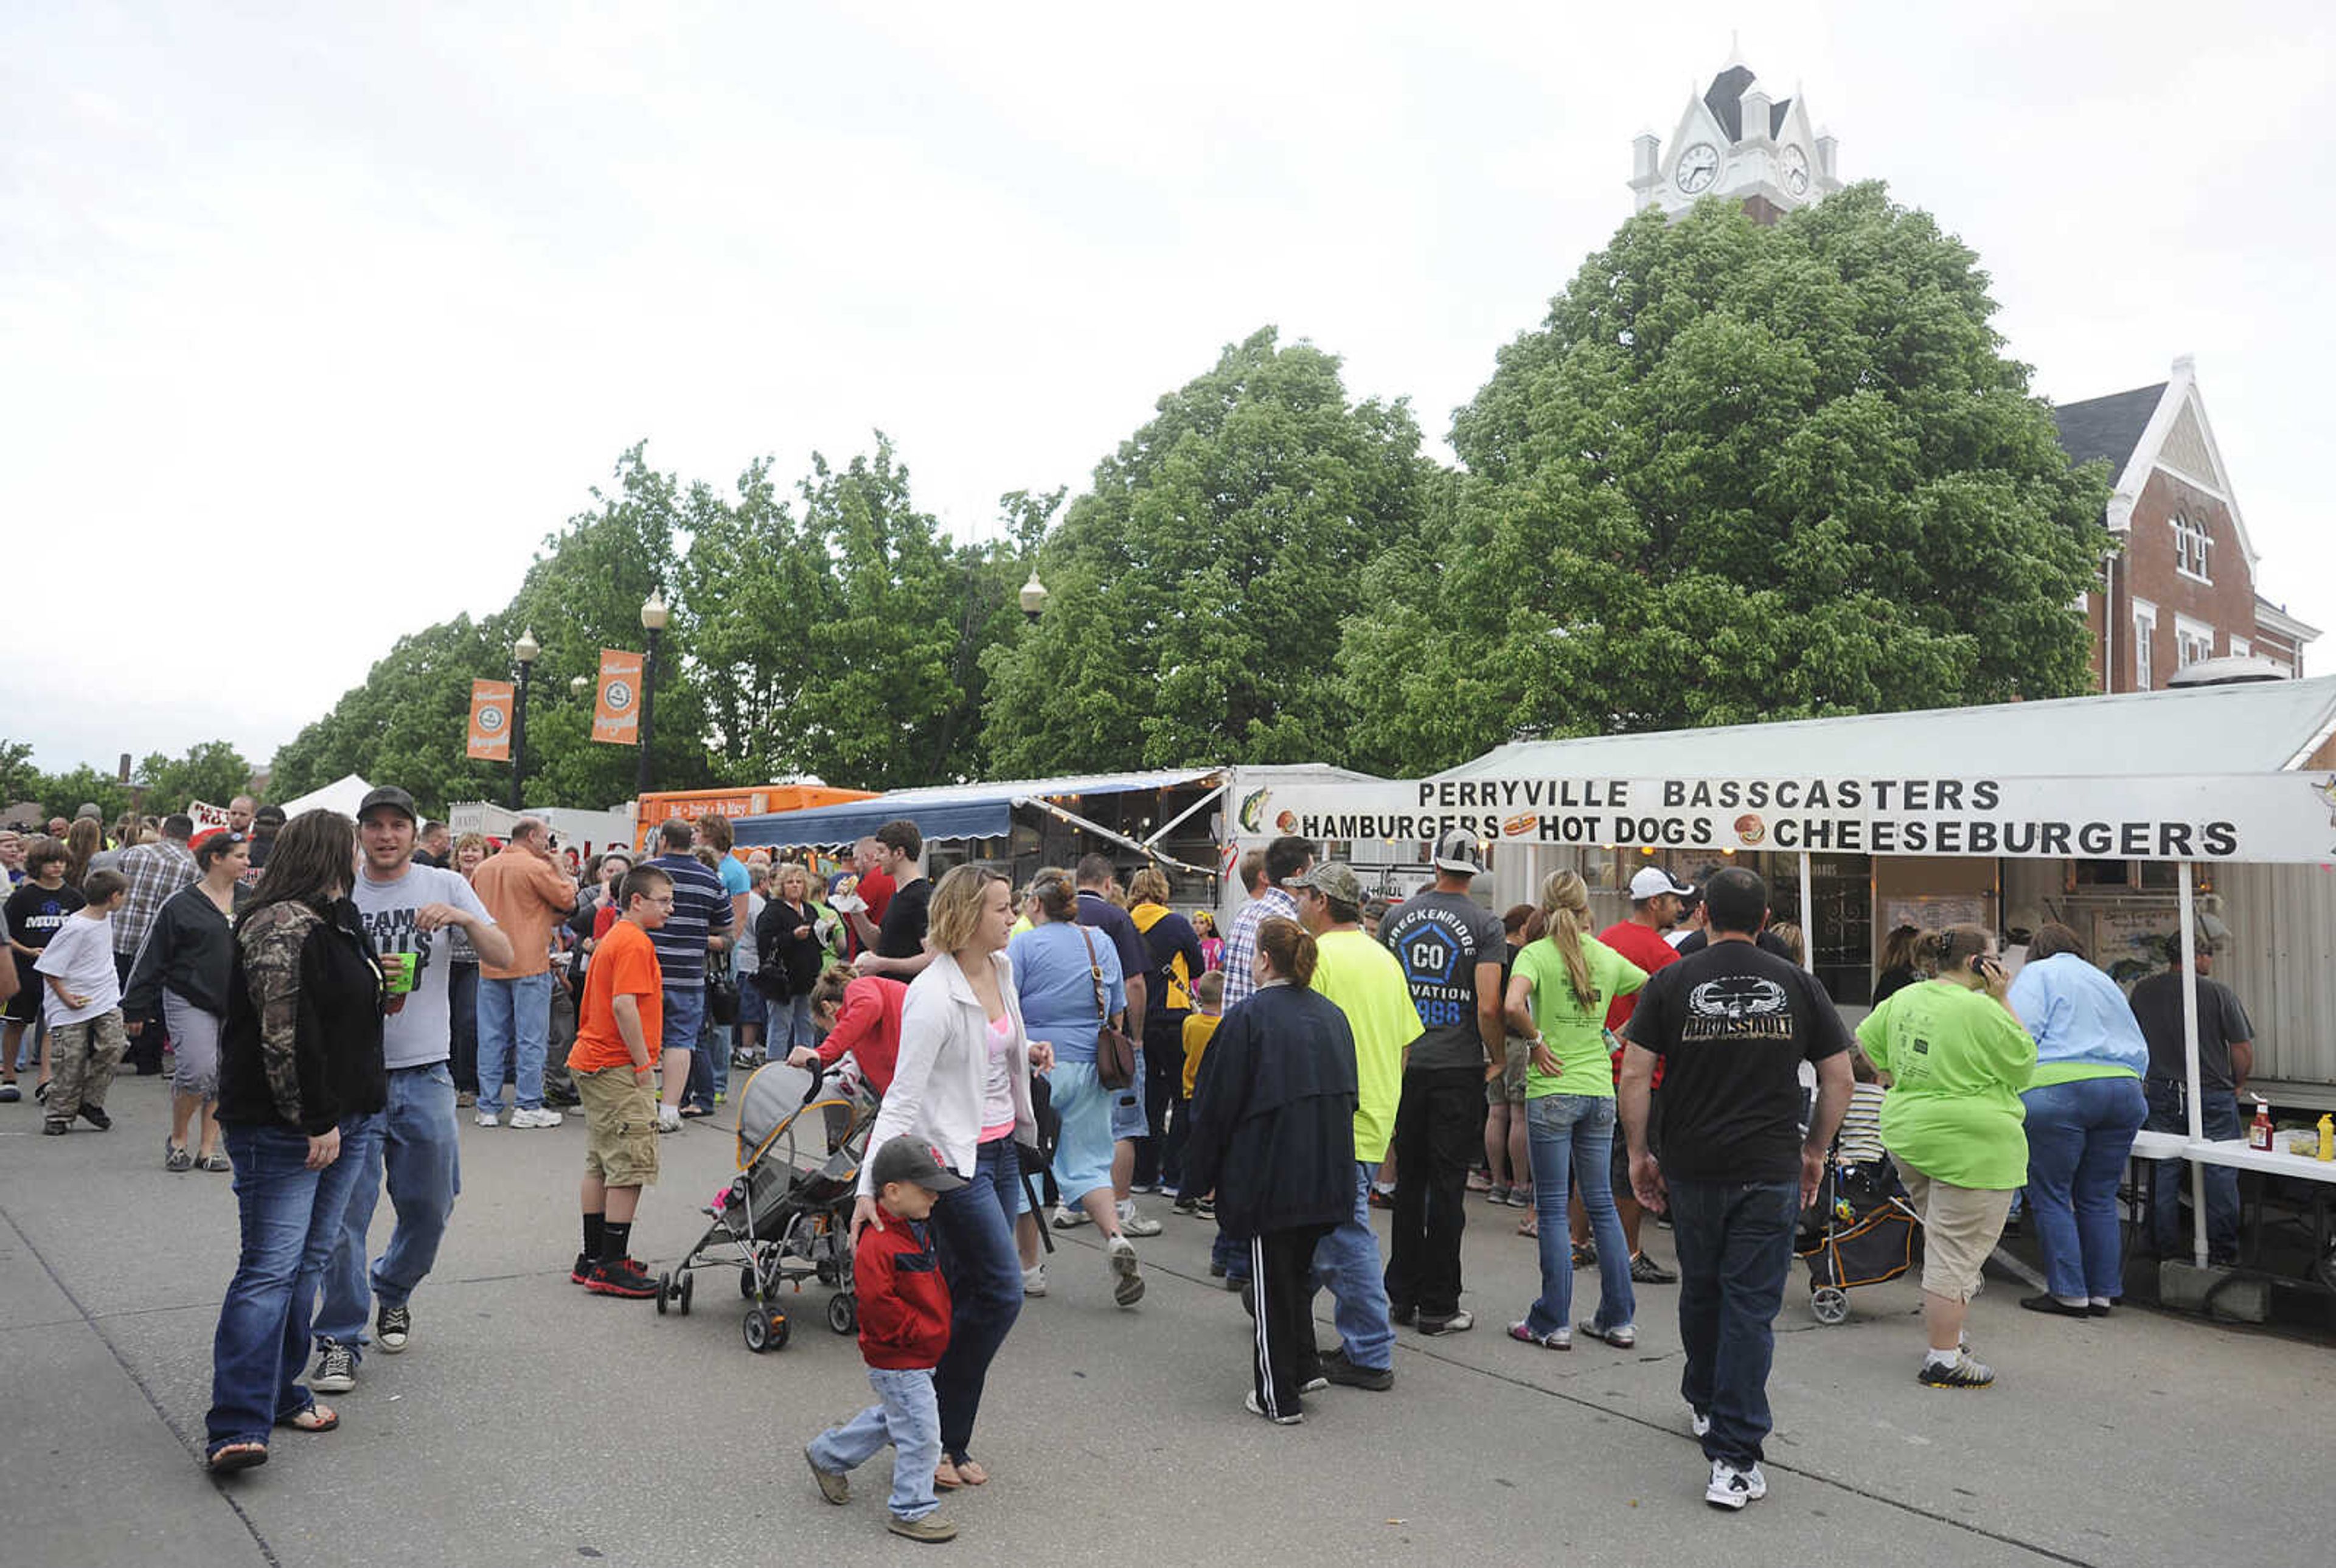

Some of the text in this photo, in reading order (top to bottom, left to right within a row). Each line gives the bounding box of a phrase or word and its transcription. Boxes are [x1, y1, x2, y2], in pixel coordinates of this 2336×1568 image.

[1419, 780, 1999, 810] PERRYVILLE BASSCASTERS
[1302, 815, 2237, 856] HAMBURGERS HOT DOGS CHEESEBURGERS
[1388, 909, 1476, 957] BRECKENRIDGE
[1413, 943, 1444, 970] CO
[1411, 984, 1471, 1002] VATION
[1415, 999, 1460, 1027] 998
